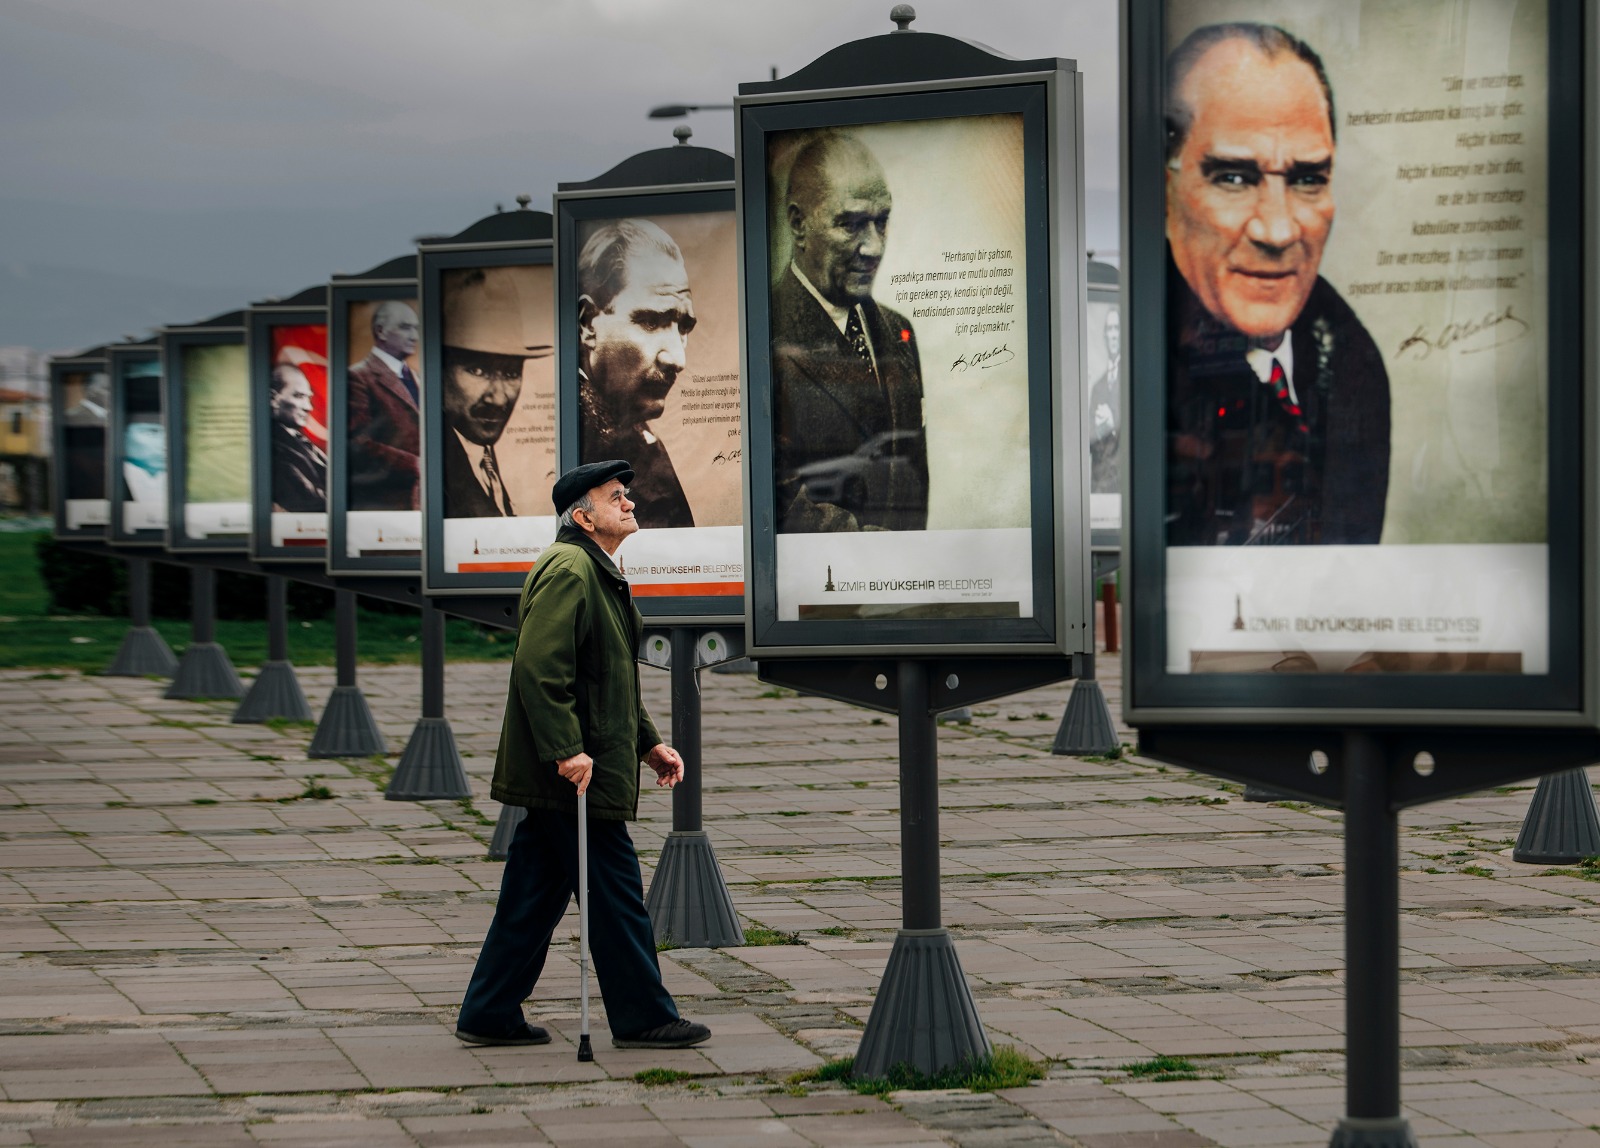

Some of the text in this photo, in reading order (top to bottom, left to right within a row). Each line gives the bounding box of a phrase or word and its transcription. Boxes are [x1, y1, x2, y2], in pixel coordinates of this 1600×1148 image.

[942, 249, 1013, 263] "Herhangi bir şahsın,
[891, 266, 1013, 285] yaşadıkça memnun ve mutlu olması
[896, 289, 908, 302] için
[909, 288, 938, 301] gereken
[954, 286, 978, 297] kendisi
[979, 285, 992, 299] için
[994, 284, 1013, 297] değil,
[913, 303, 1014, 317] kendisinden sonra gelecekler
[955, 323, 968, 336] için
[727, 428, 737, 437] çok
[838, 578, 993, 591] İZMİR BÜYÜKŞEHİR BELEDİYESİ
